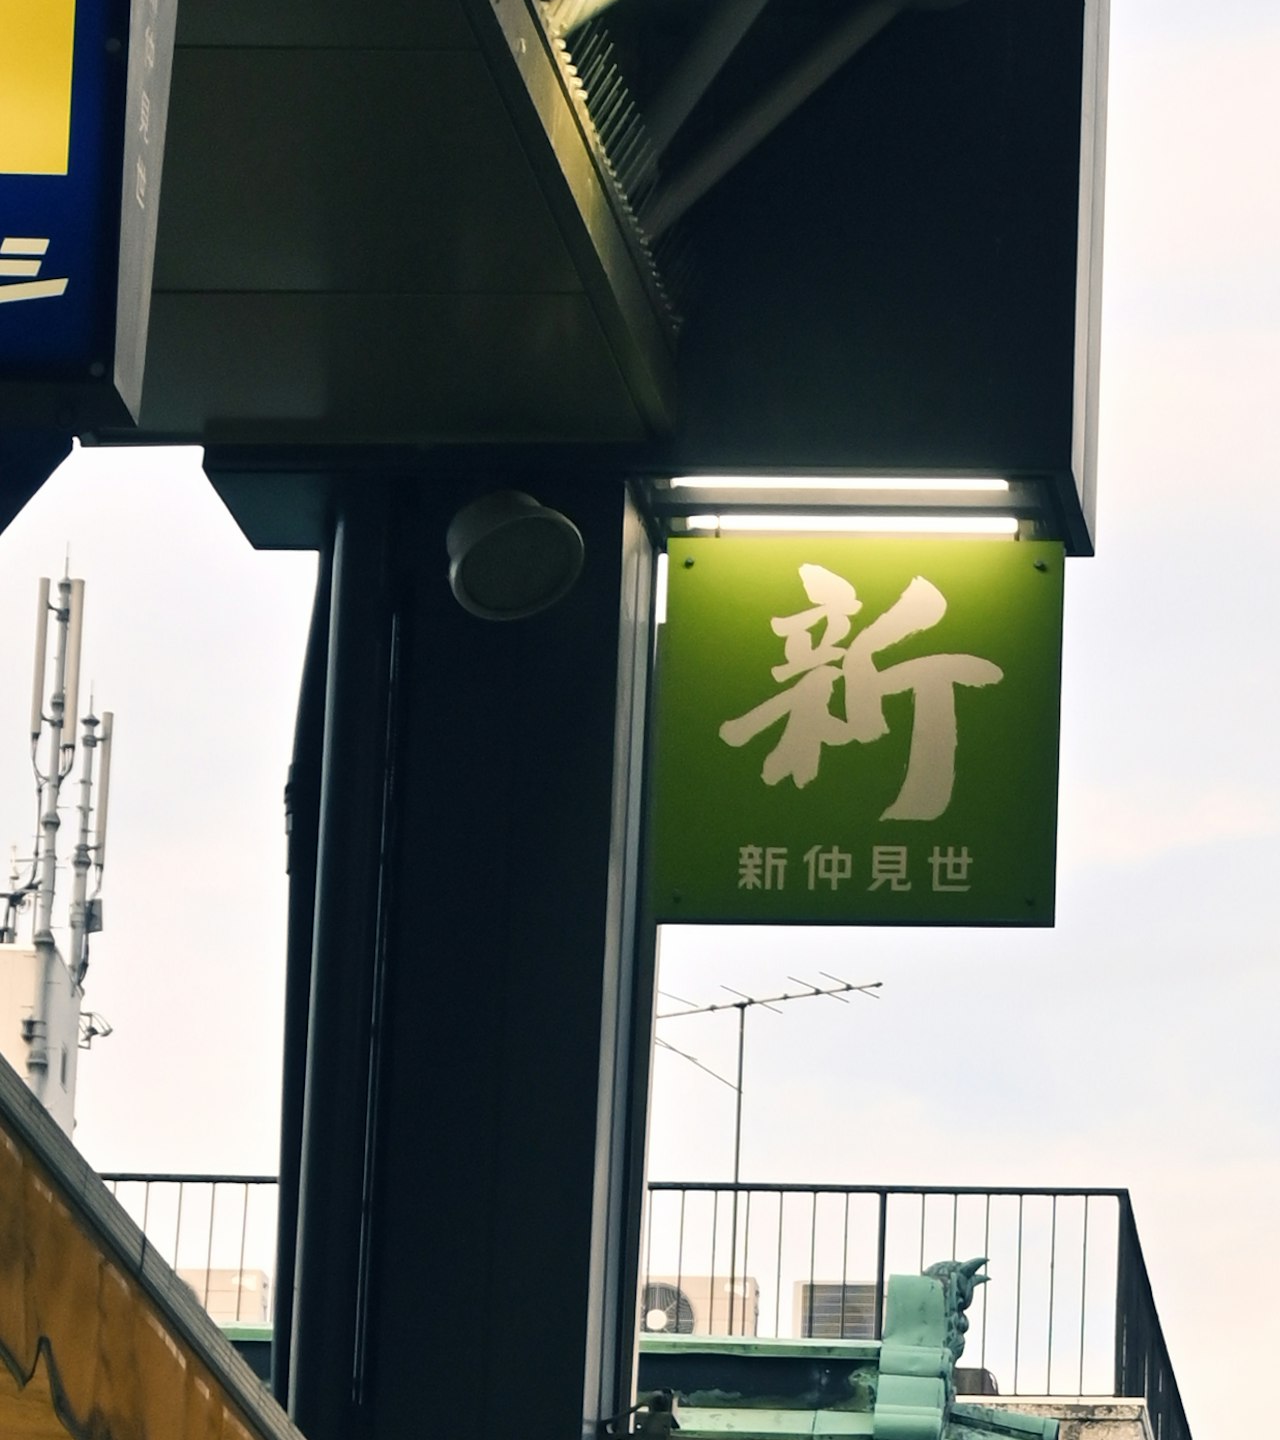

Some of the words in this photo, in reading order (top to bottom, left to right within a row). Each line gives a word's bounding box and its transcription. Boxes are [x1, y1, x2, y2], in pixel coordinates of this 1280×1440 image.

[720, 563, 1004, 820] 新
[737, 845, 973, 892] 新仲見世
